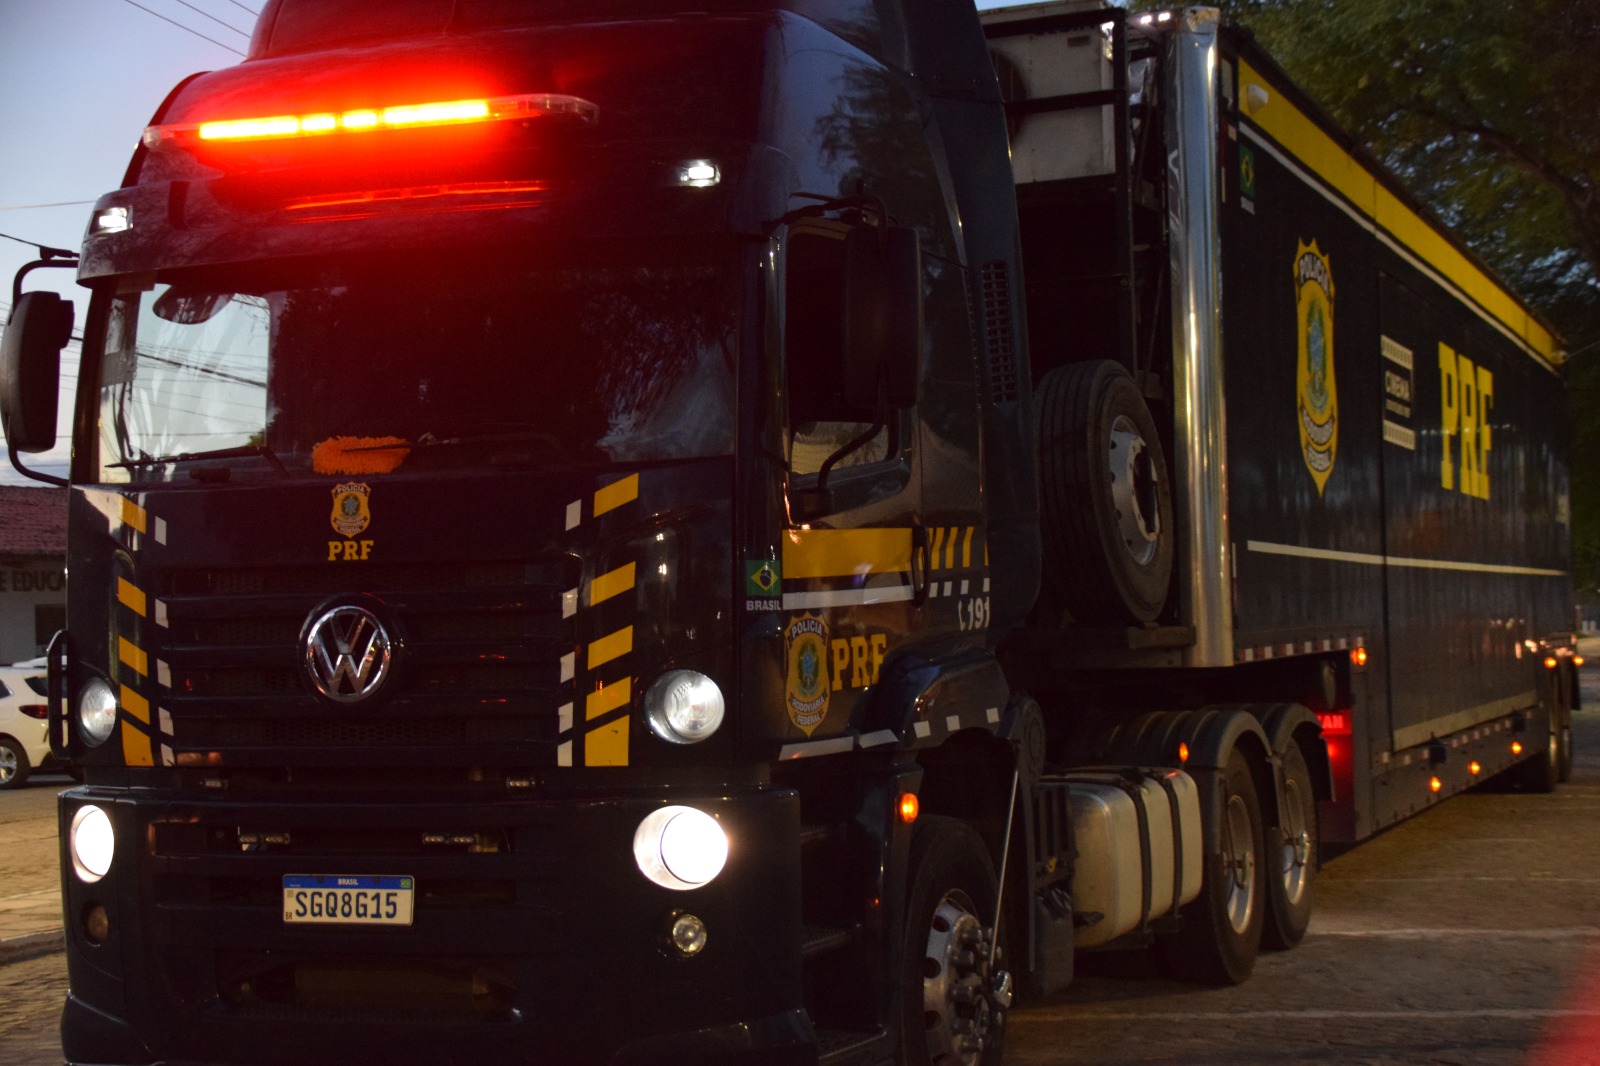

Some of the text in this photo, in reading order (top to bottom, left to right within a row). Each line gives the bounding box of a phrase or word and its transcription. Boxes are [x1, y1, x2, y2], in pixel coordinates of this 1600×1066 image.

[1438, 340, 1494, 500] PRF
[327, 540, 375, 562] PRF
[746, 599, 782, 612] BRASIL
[968, 596, 991, 631] 191
[831, 633, 887, 692] PRF
[796, 713, 821, 727] FEDERAL
[337, 878, 359, 886] BRASIL
[295, 891, 398, 919] SGQ8G15
